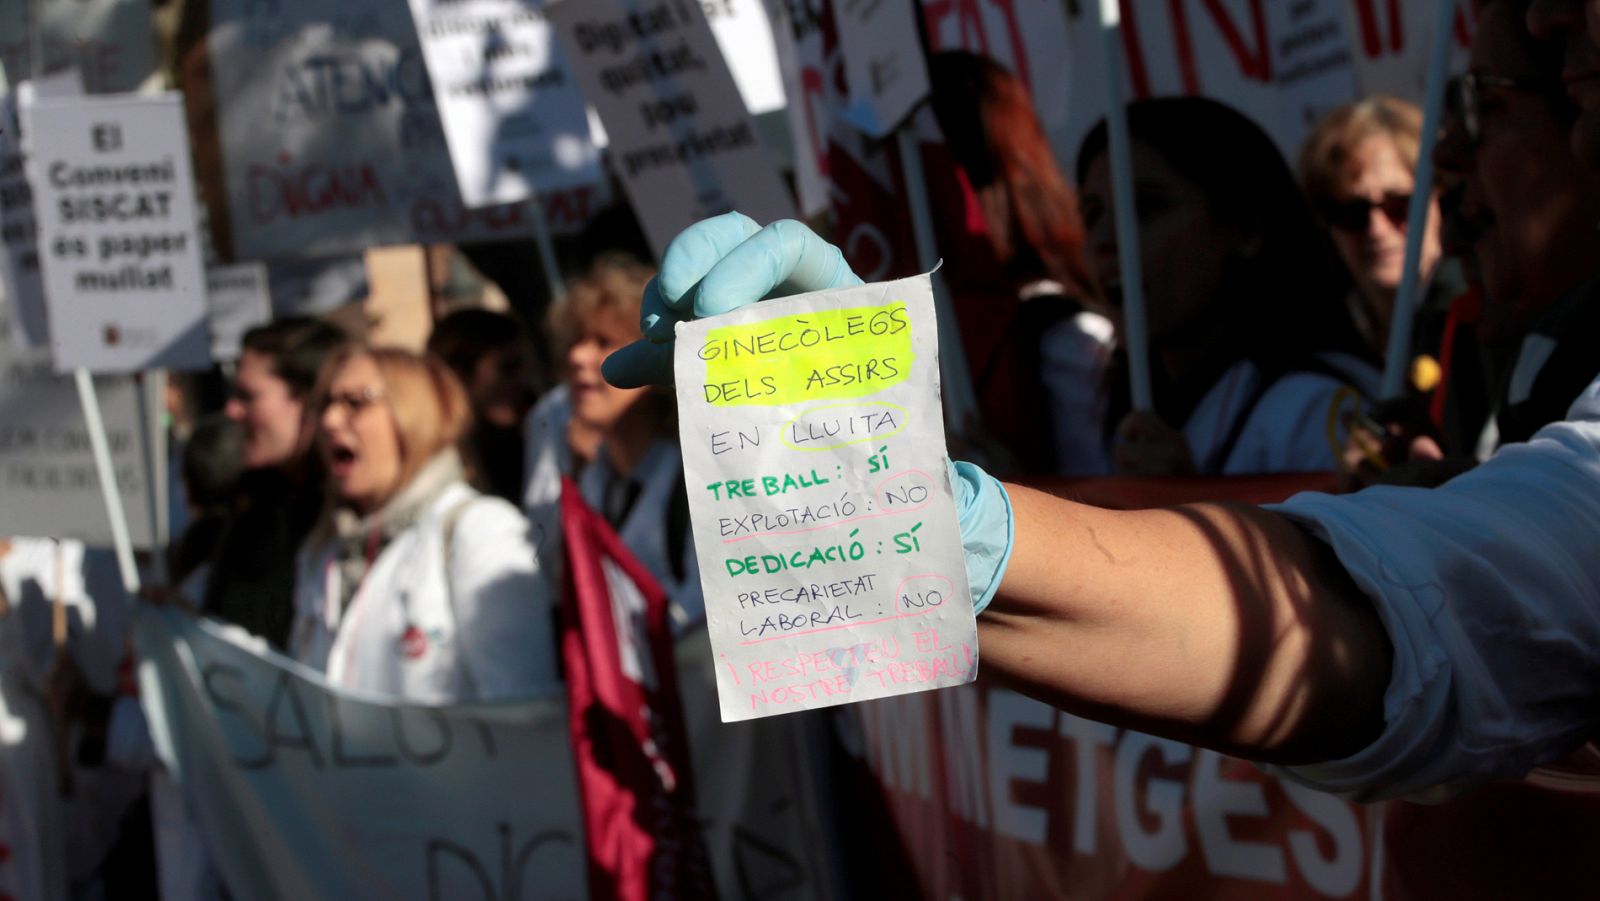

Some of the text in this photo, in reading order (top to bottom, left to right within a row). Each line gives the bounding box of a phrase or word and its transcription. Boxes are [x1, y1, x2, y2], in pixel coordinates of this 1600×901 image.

[91, 121, 122, 150] El
[50, 160, 175, 189] Conveni
[59, 193, 172, 222] SISCAT
[101, 232, 188, 261] paper
[75, 266, 174, 292] mullat
[698, 307, 907, 361] GINECÒLEGS
[703, 358, 899, 404] DELS ASSIRS
[711, 411, 897, 456] EN LLUITA
[886, 485, 927, 505] NO
[892, 522, 922, 555] SÍ
[738, 574, 877, 609] PRECARIETAT
[902, 591, 943, 609] NO
[913, 627, 951, 651] EL
[751, 674, 850, 710] NOSTRE
